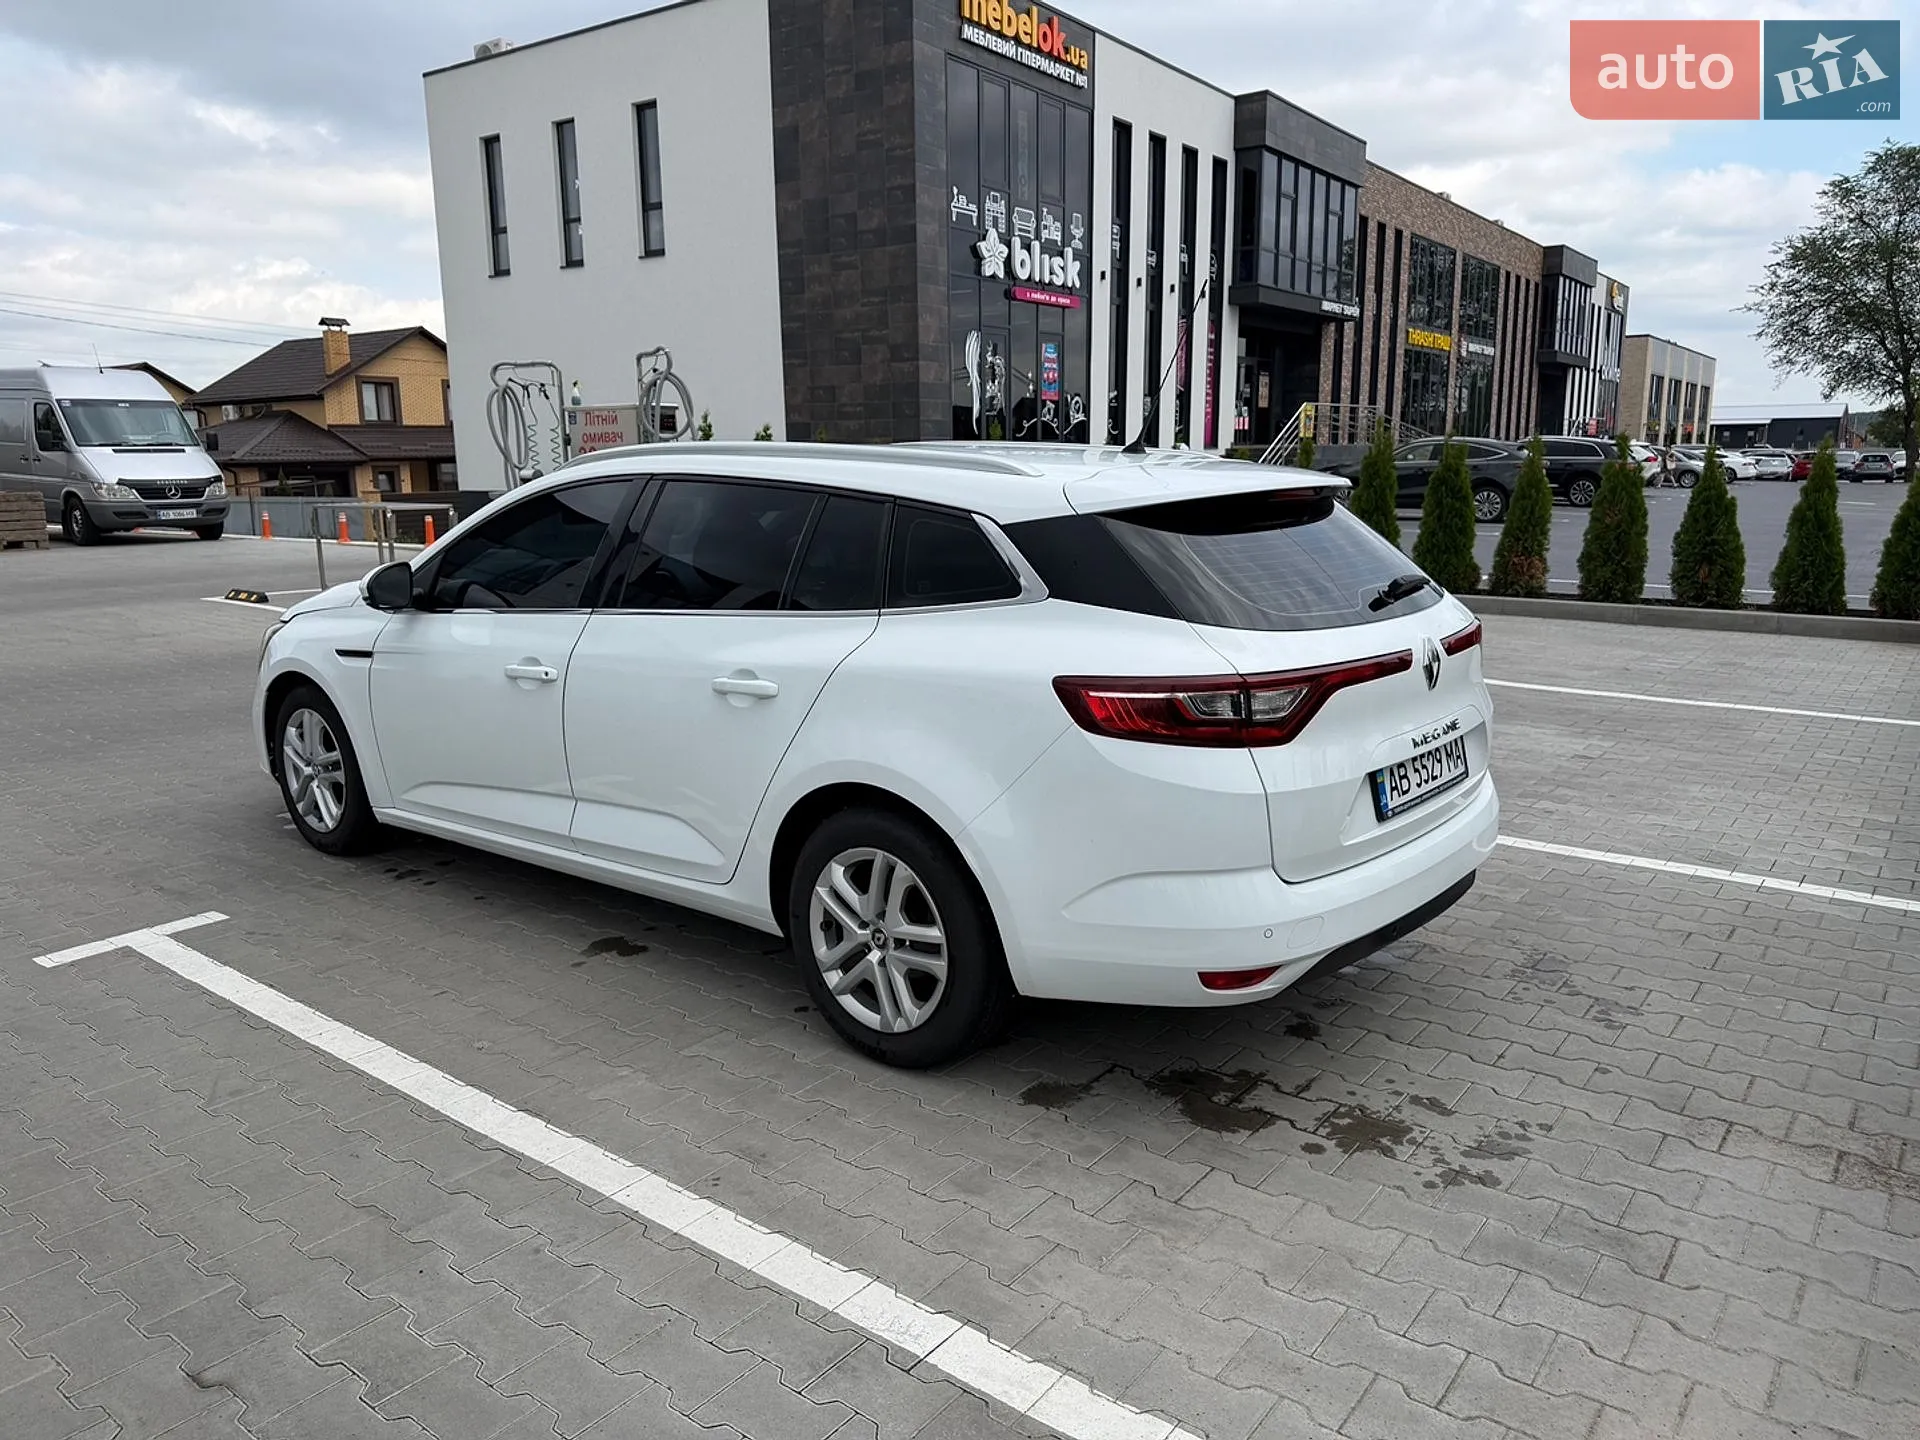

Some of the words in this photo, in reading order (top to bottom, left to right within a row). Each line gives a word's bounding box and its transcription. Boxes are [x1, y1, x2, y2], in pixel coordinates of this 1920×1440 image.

[961, 0, 1088, 70] mebelok.ua
[961, 23, 1016, 60] МЕБЛЕВИЙ
[1017, 46, 1076, 84] ГІПЕРМАРКЕТ
[1011, 235, 1081, 289] blisk
[581, 430, 624, 445] омивач
[584, 410, 619, 427] Літній
[1411, 718, 1461, 749] MEGANE
[1389, 762, 1411, 802] AB
[1411, 747, 1443, 789] 5529
[1443, 736, 1463, 773] MA
